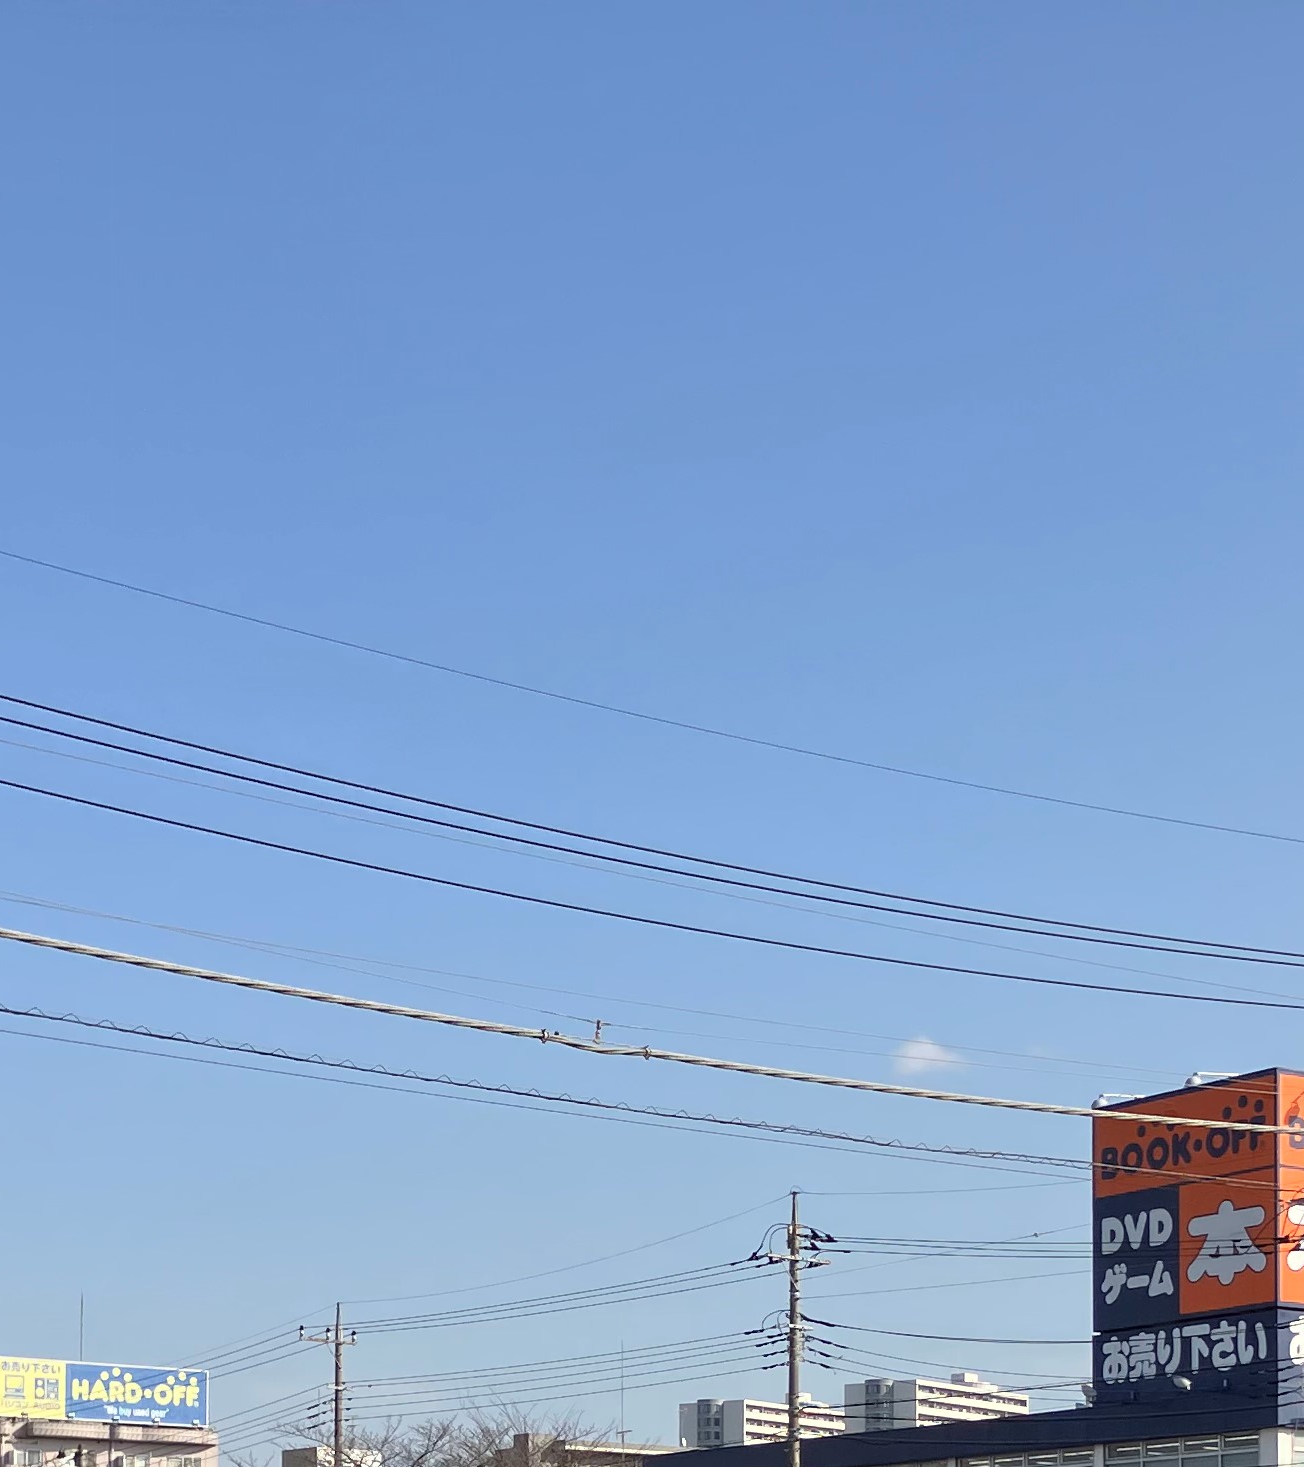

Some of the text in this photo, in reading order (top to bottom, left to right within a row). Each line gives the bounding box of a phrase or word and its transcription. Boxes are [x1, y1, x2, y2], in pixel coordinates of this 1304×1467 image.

[1101, 1208, 1173, 1255] DVD
[1186, 1199, 1267, 1285] 本
[1101, 1260, 1174, 1304] ゲーム
[1102, 1320, 1267, 1384] お売り下さい
